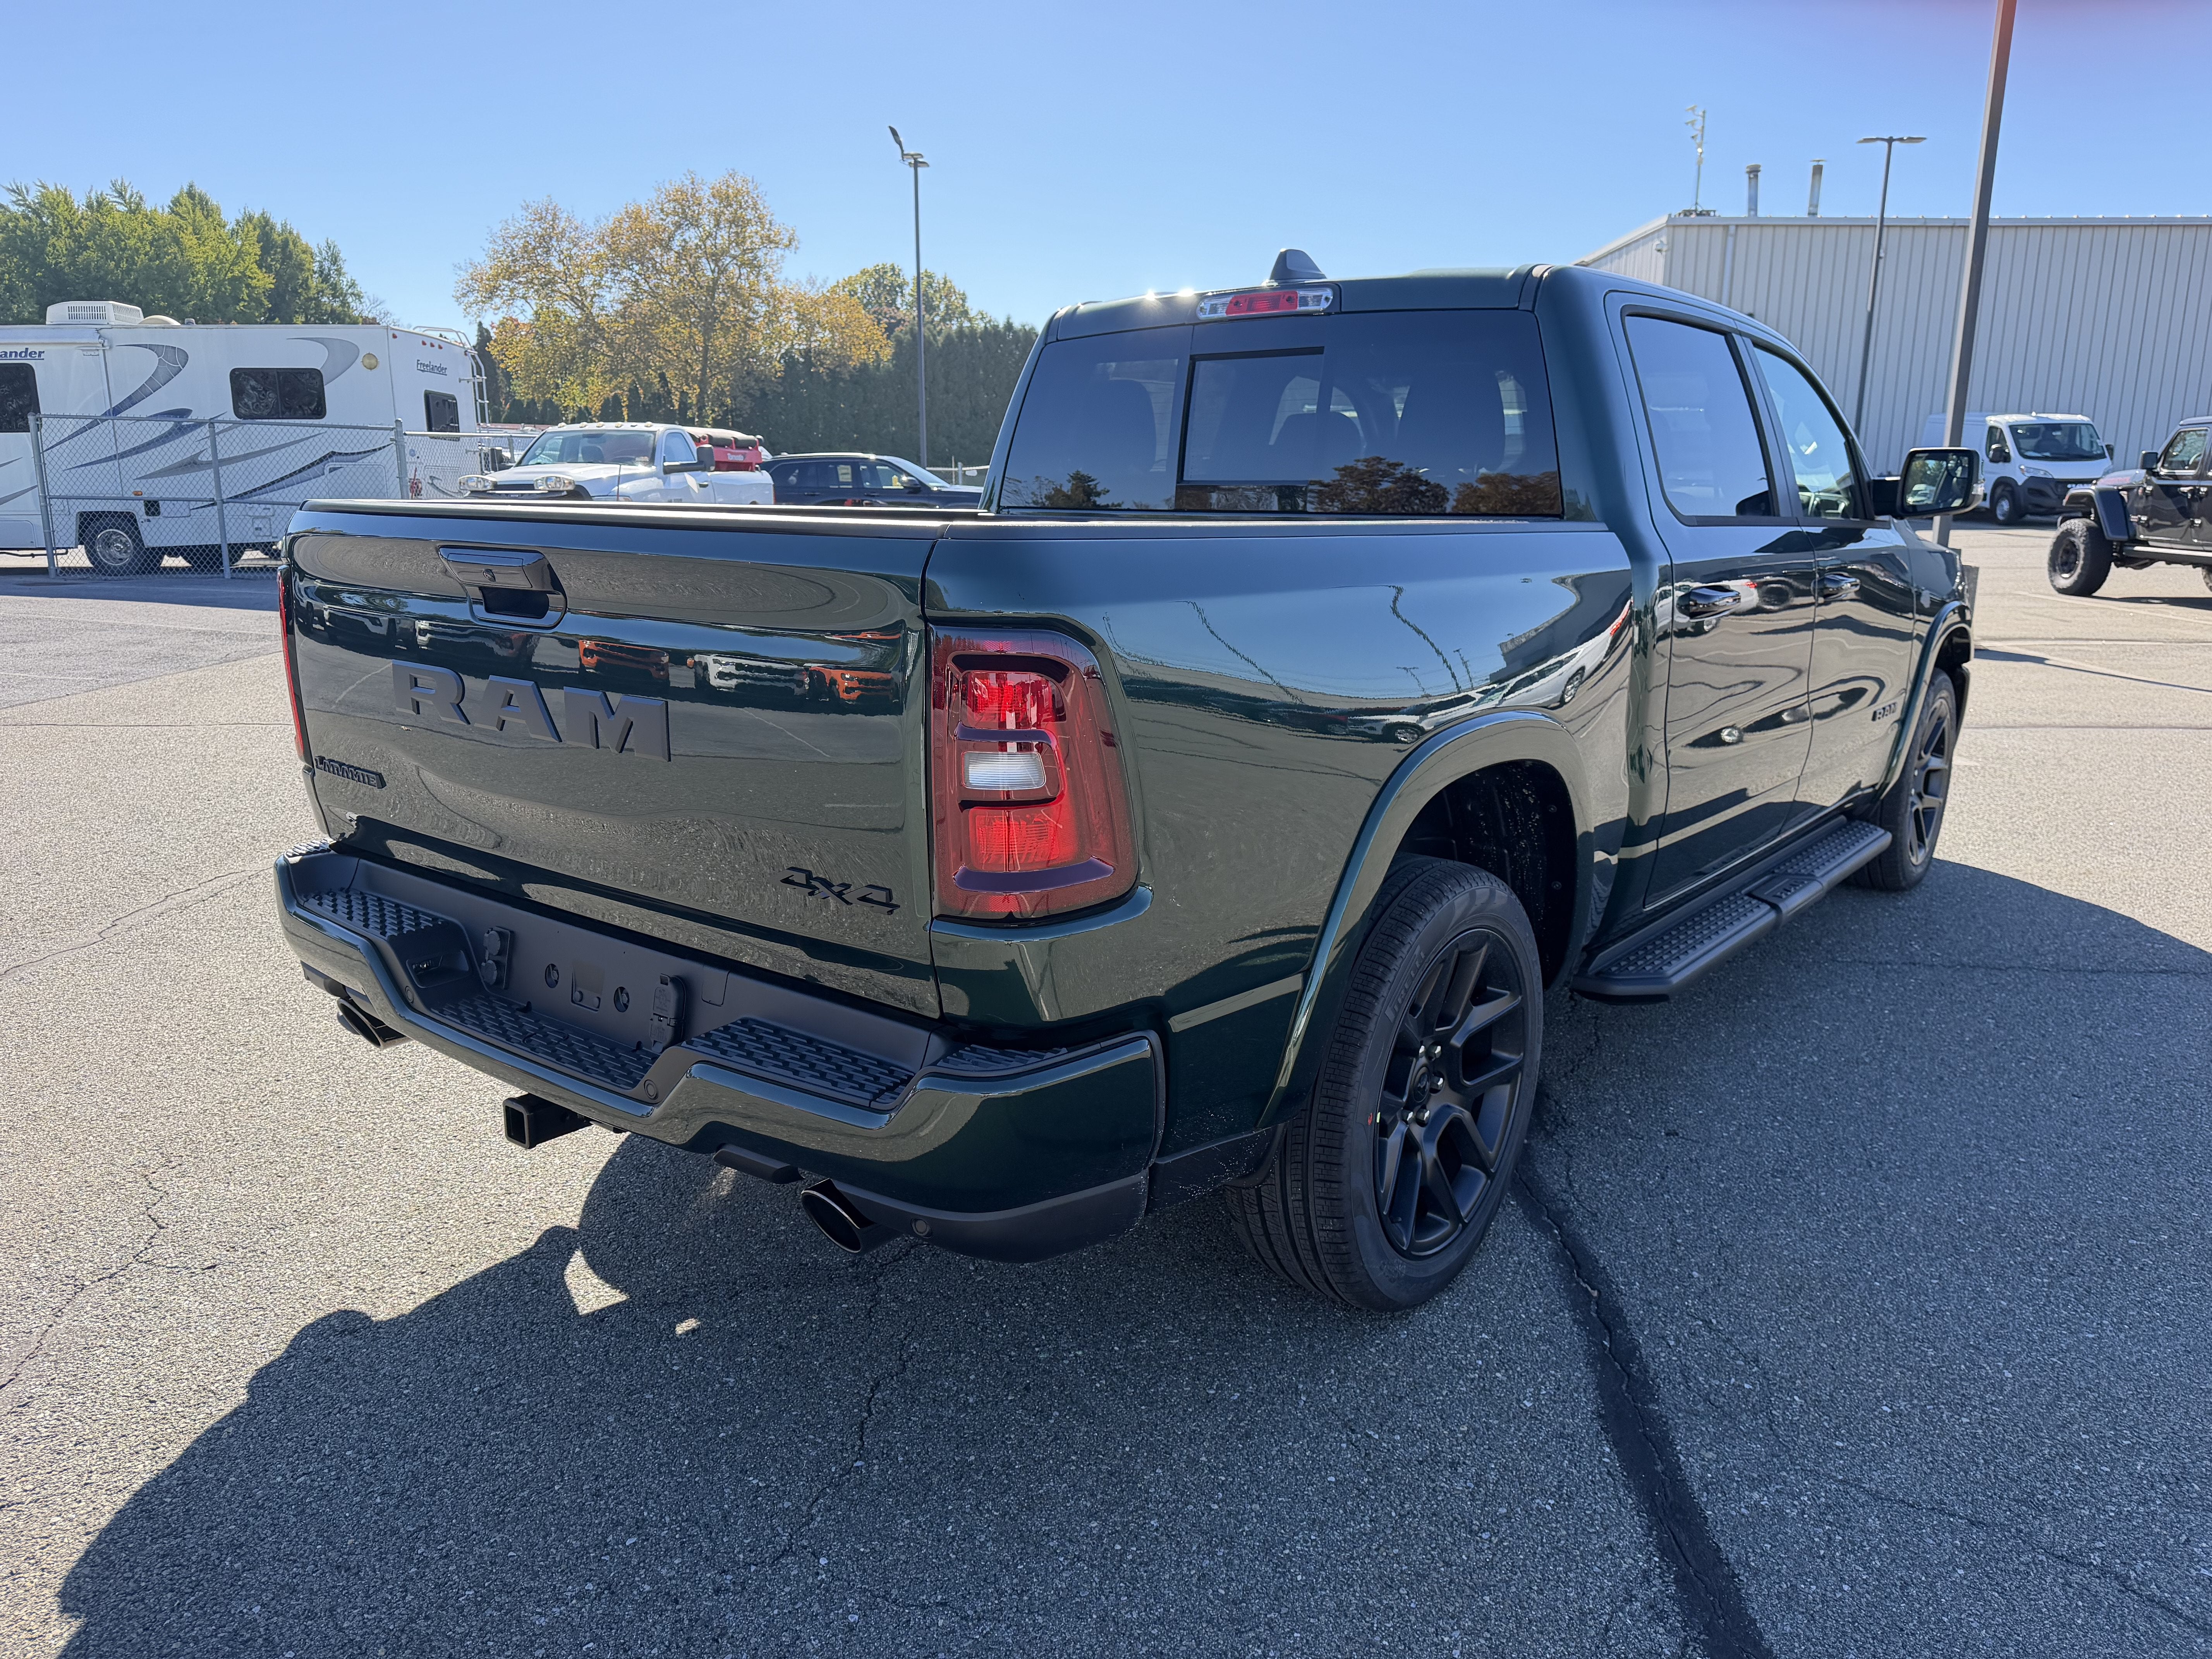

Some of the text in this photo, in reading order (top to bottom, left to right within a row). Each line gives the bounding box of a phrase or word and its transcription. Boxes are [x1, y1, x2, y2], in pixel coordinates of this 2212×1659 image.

[417, 359, 447, 374] Freelander
[392, 659, 672, 762] RAM
[1872, 702, 1896, 721] RAM
[314, 756, 378, 787] LARAMIE
